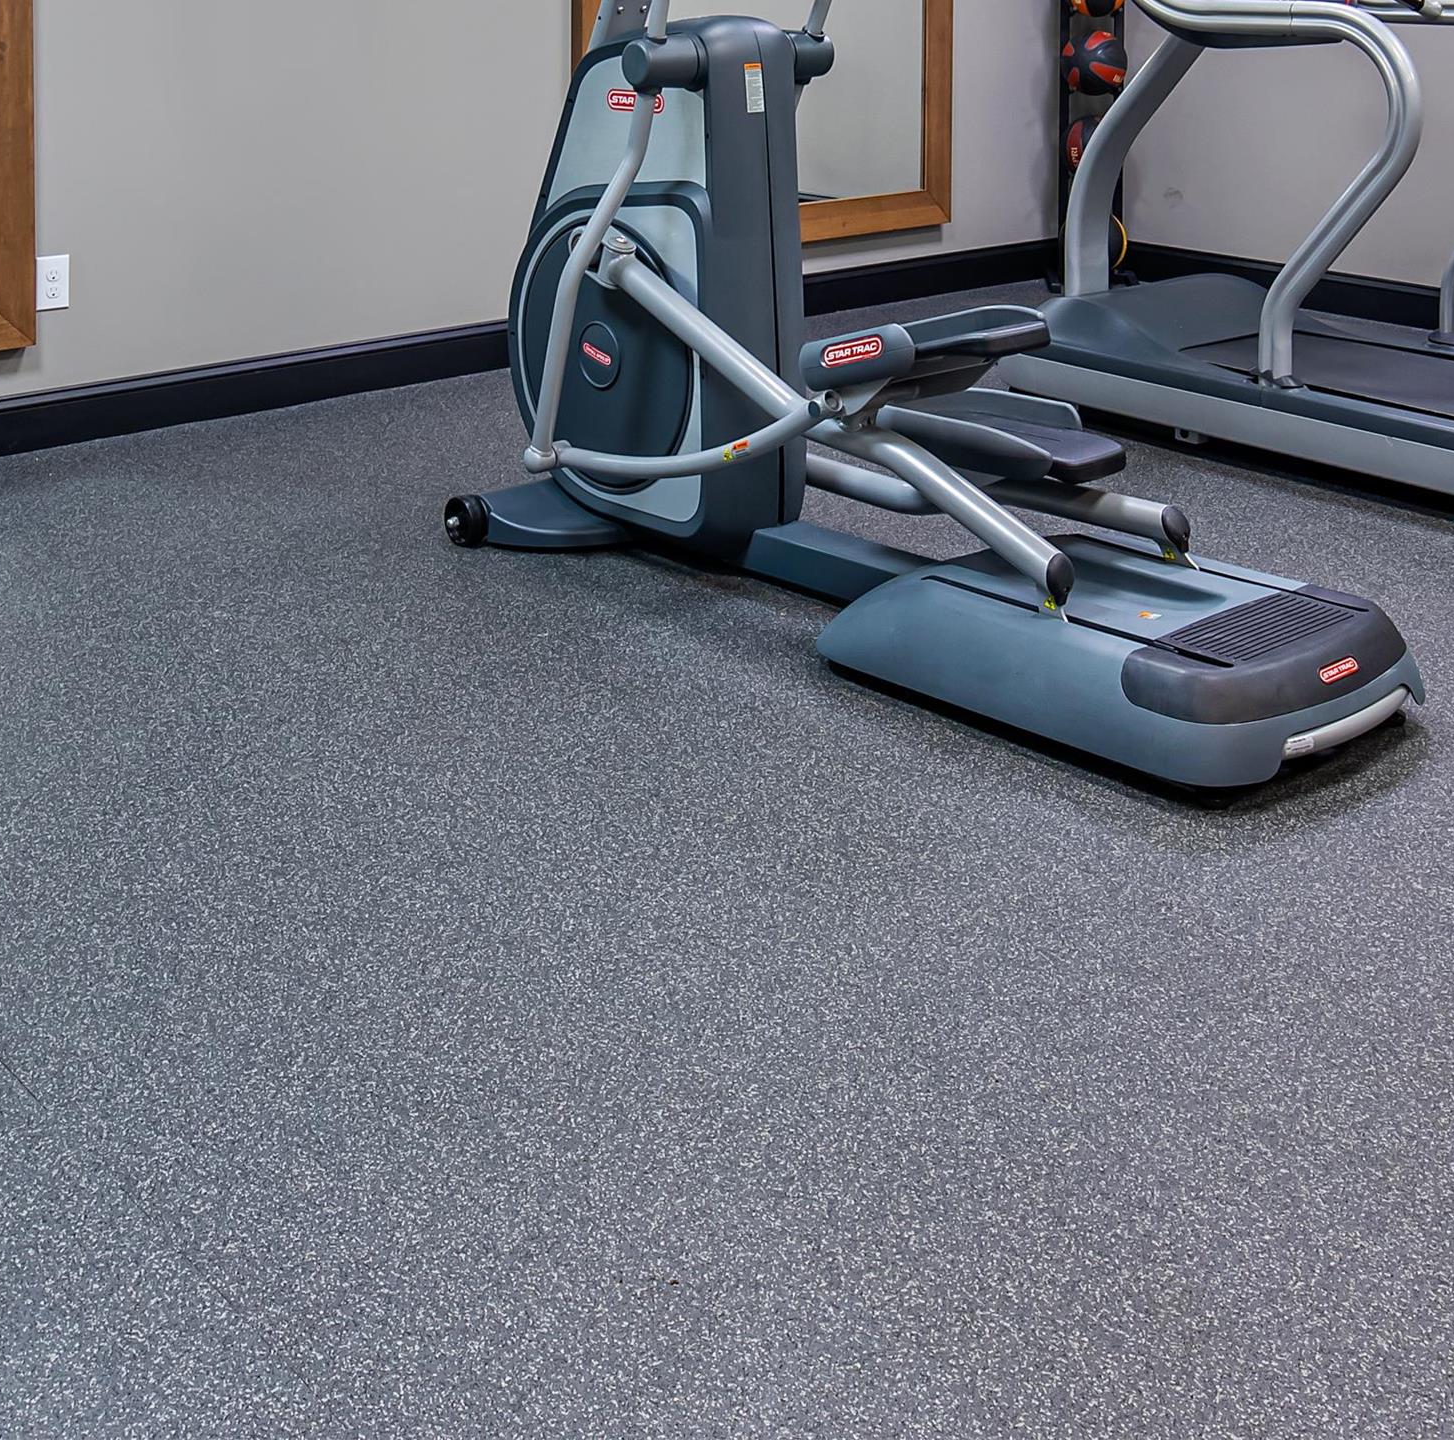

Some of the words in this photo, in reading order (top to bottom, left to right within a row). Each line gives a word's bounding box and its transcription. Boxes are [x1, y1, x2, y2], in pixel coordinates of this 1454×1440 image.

[612, 95, 635, 105] STAR
[828, 348, 851, 359] STAR
[852, 342, 878, 355] TRAC
[1322, 667, 1339, 679] STAR
[1338, 660, 1355, 671] TRAC
